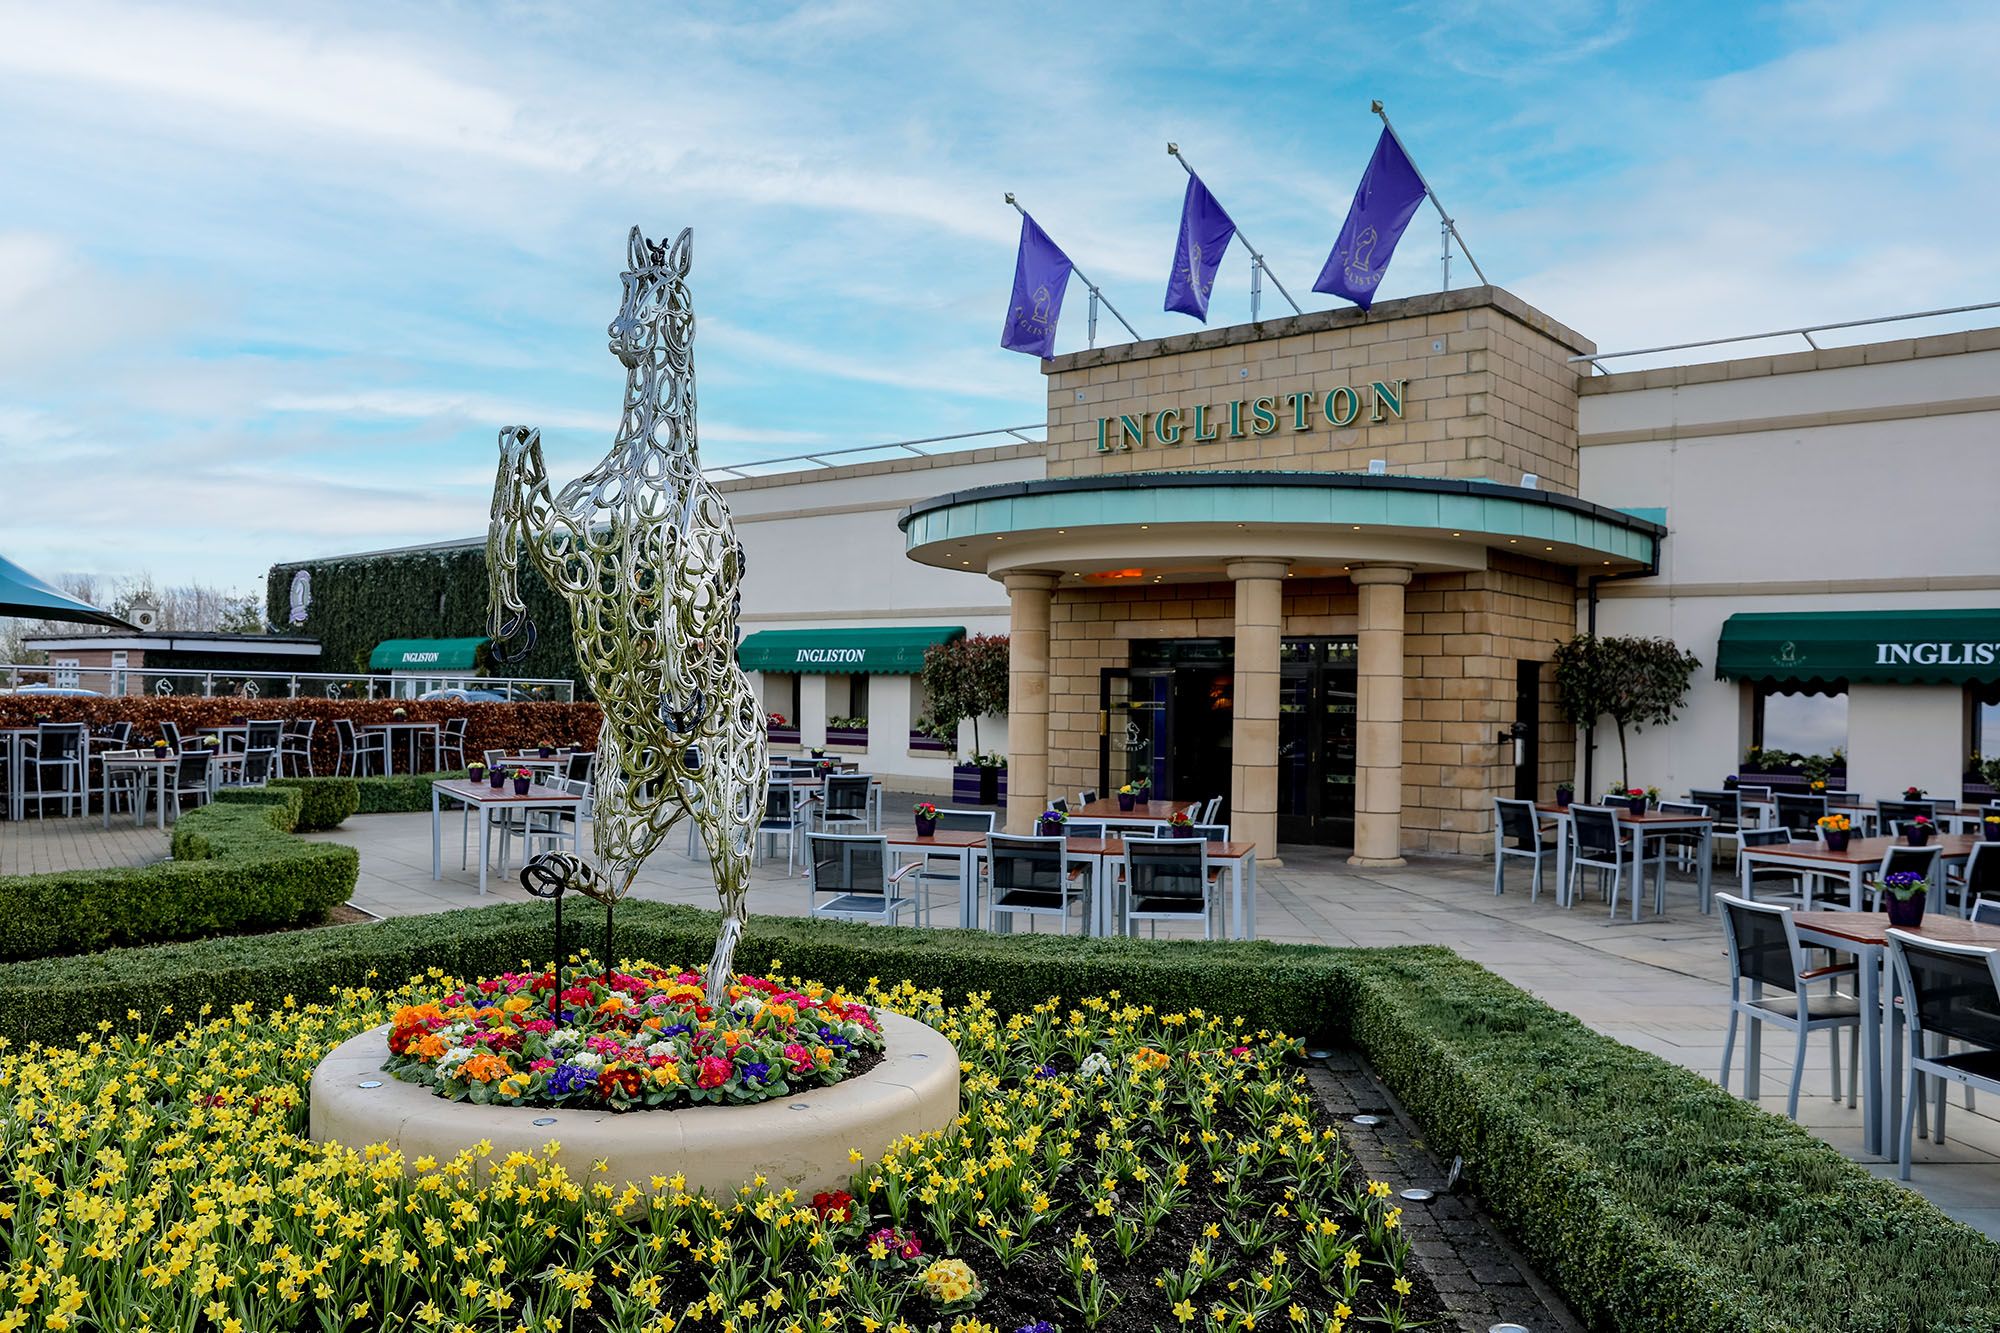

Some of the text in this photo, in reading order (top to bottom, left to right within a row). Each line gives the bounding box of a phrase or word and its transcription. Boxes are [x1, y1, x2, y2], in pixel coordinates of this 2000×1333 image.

[1096, 378, 1407, 452] INGLISTON
[402, 652, 440, 663] INGLISTON
[796, 648, 866, 662] INGLISTON
